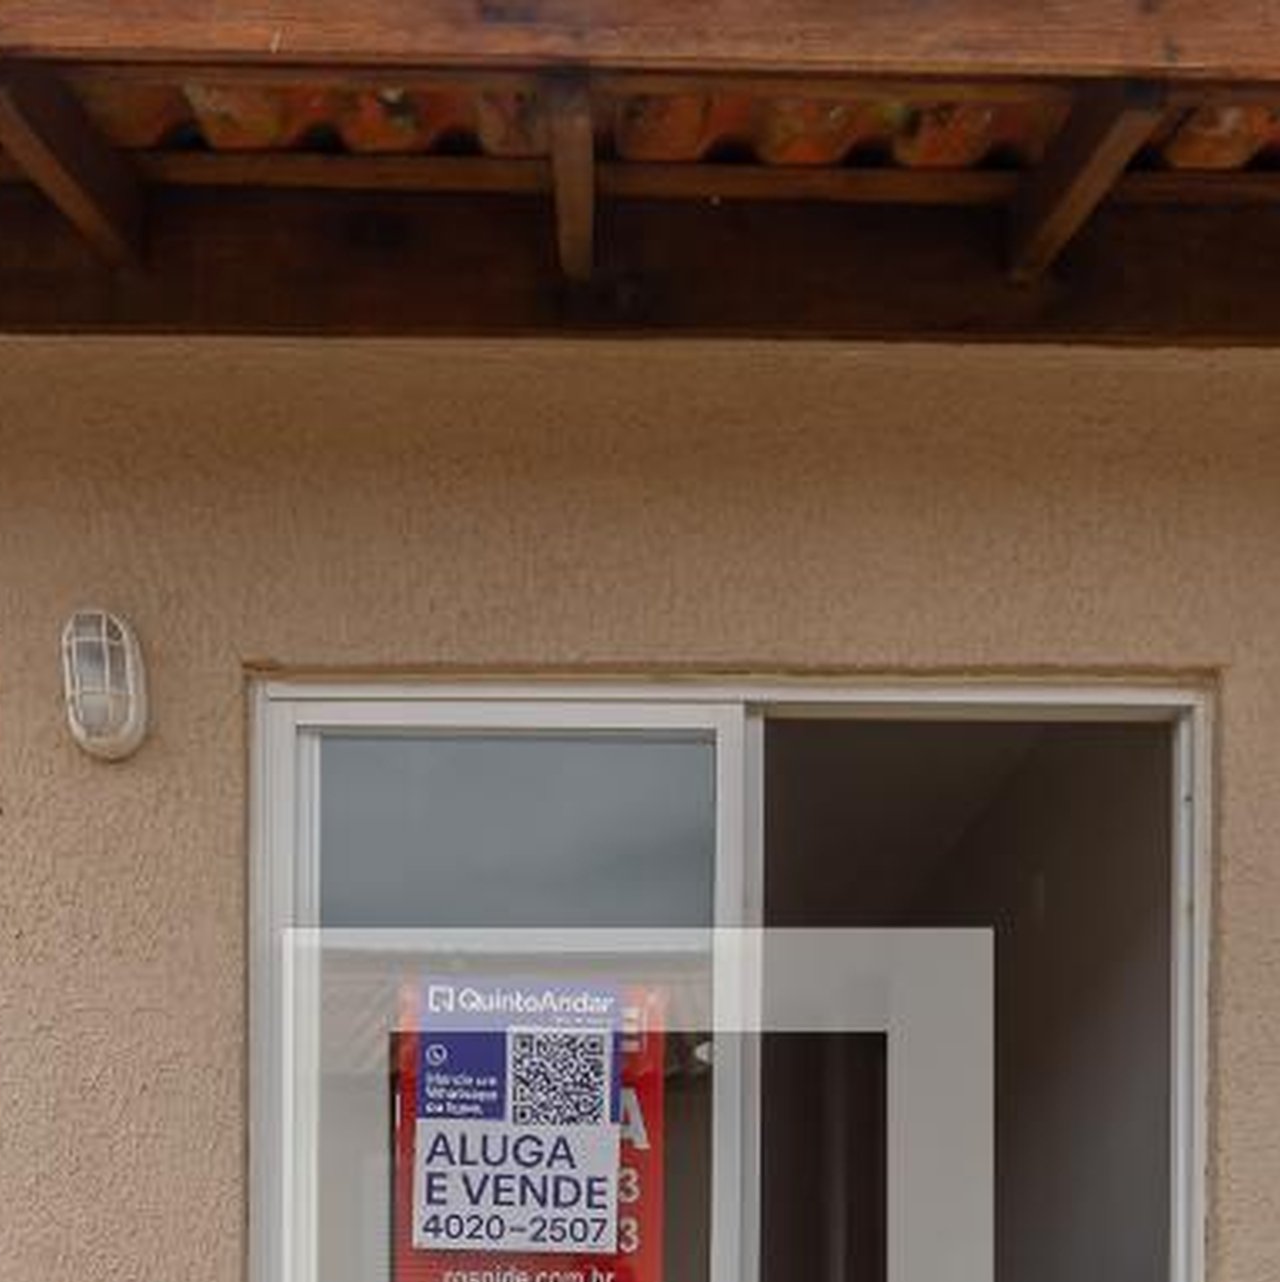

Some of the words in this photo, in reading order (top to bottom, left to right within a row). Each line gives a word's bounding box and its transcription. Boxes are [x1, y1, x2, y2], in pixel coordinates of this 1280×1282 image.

[459, 986, 614, 1013] QuintoAndar
[425, 1133, 577, 1170] ALUGA
[425, 1172, 448, 1206] E
[462, 1173, 608, 1210] VENDE
[423, 1214, 608, 1243] 4020-2507
